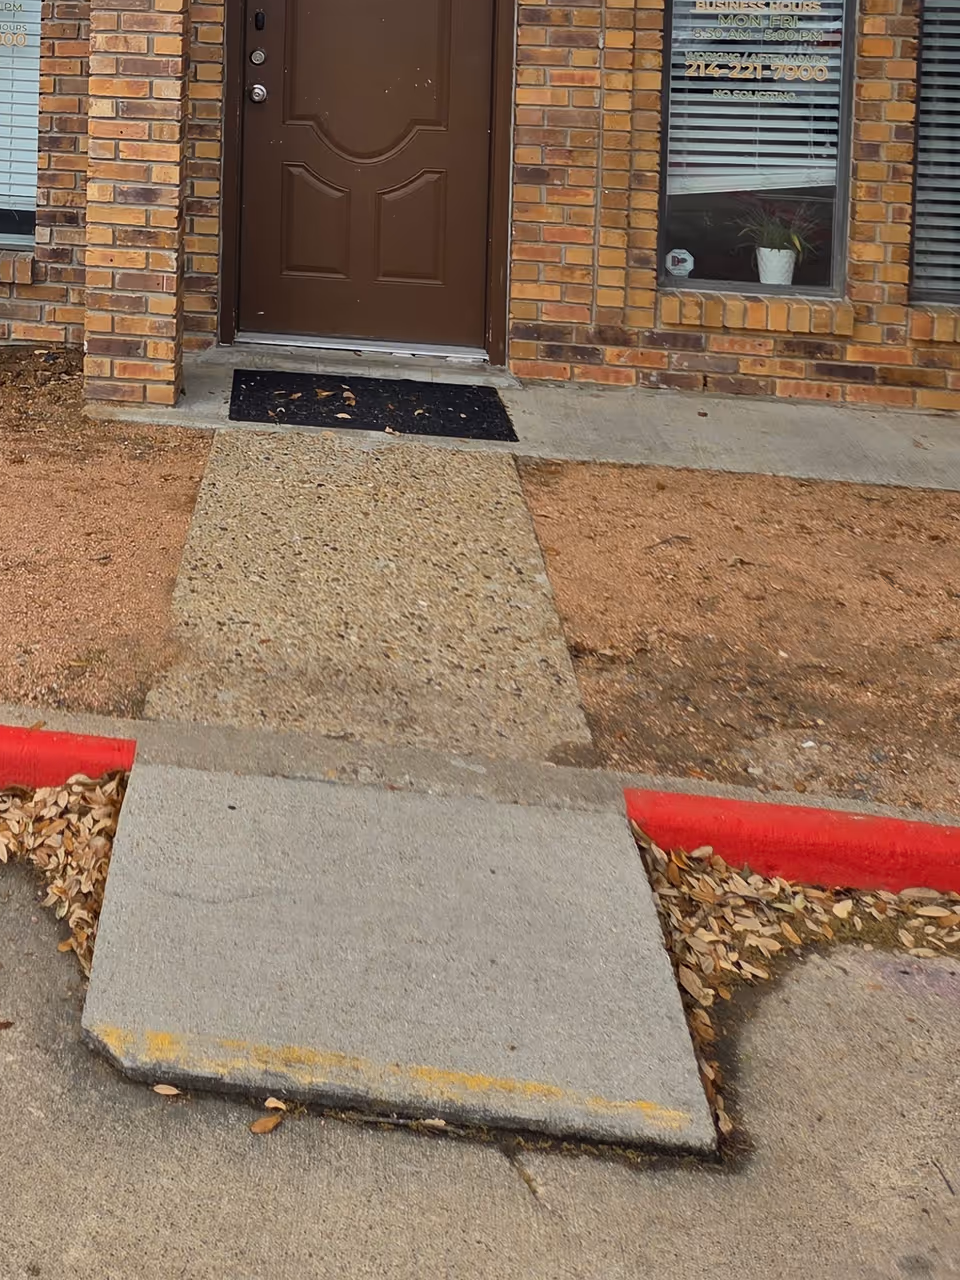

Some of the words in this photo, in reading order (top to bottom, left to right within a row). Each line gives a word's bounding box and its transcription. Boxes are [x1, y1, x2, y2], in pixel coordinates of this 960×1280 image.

[4, 4, 22, 12] PM
[696, 0, 767, 11] BUSINESS
[769, 2, 822, 12] HOURS
[727, 29, 752, 39] AM
[764, 30, 795, 41] 5:00
[800, 31, 823, 41] PM
[685, 51, 741, 63] WORKING
[685, 61, 828, 81] 214-221-7900
[713, 90, 730, 98] NO
